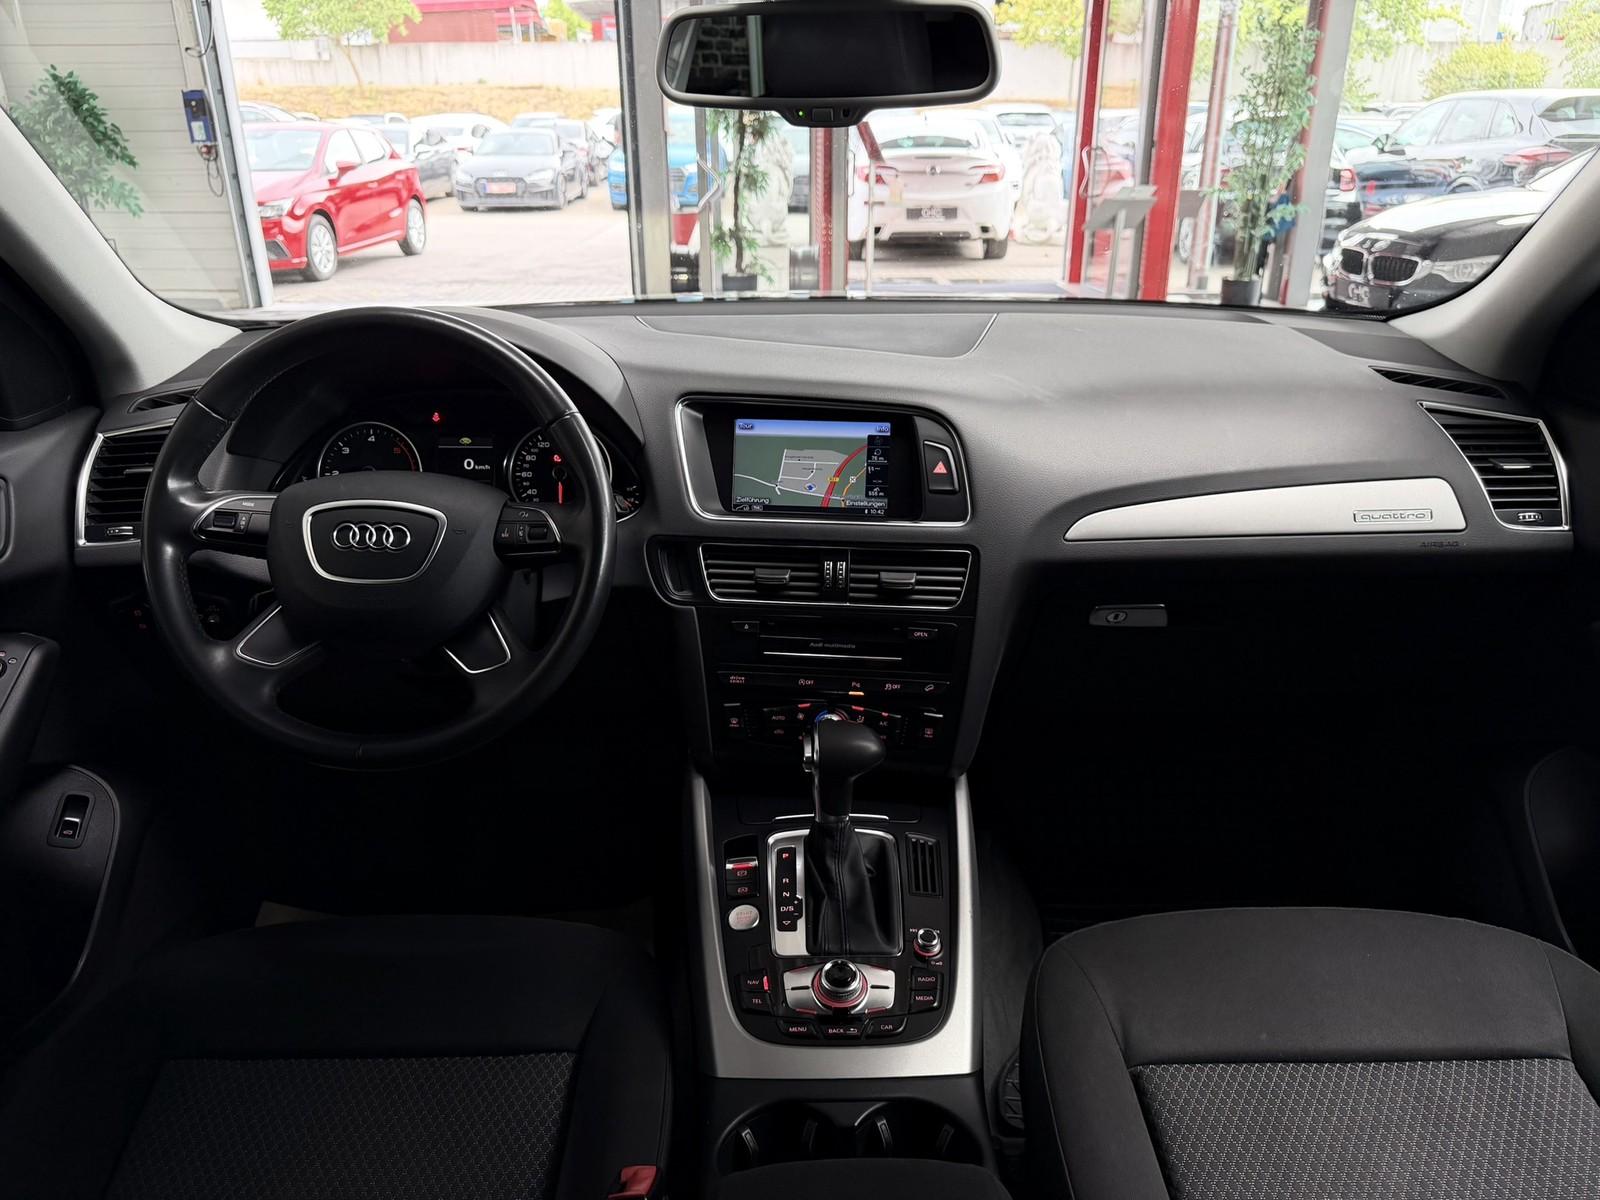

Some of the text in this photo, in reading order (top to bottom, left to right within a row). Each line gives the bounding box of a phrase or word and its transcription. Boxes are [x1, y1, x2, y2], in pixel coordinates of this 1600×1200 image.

[463, 458, 475, 470] 0
[736, 496, 770, 504] Zielführung
[846, 500, 886, 508] Einstellungen
[1360, 512, 1426, 521] quattro
